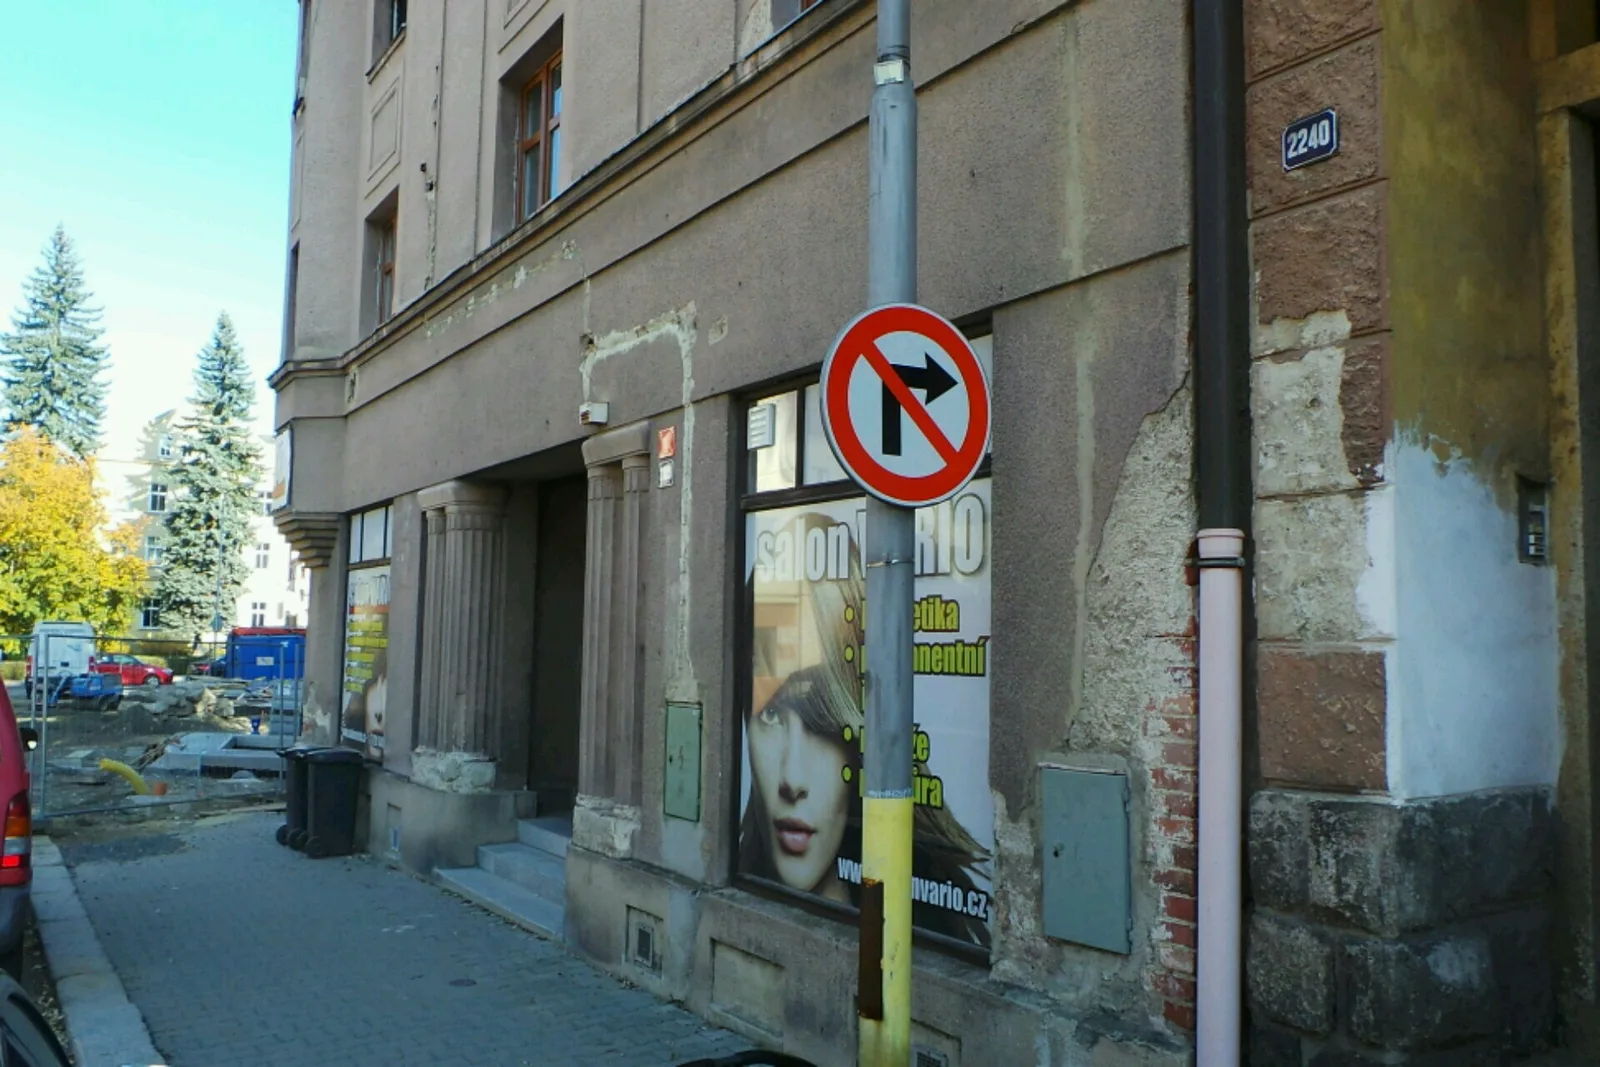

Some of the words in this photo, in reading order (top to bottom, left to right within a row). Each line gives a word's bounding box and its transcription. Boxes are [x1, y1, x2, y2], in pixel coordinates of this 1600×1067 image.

[1287, 120, 1330, 158] 2240
[757, 517, 850, 583] salon
[856, 493, 985, 580] RIO
[861, 594, 960, 632] etika
[837, 857, 988, 919] wwnvario.cz
